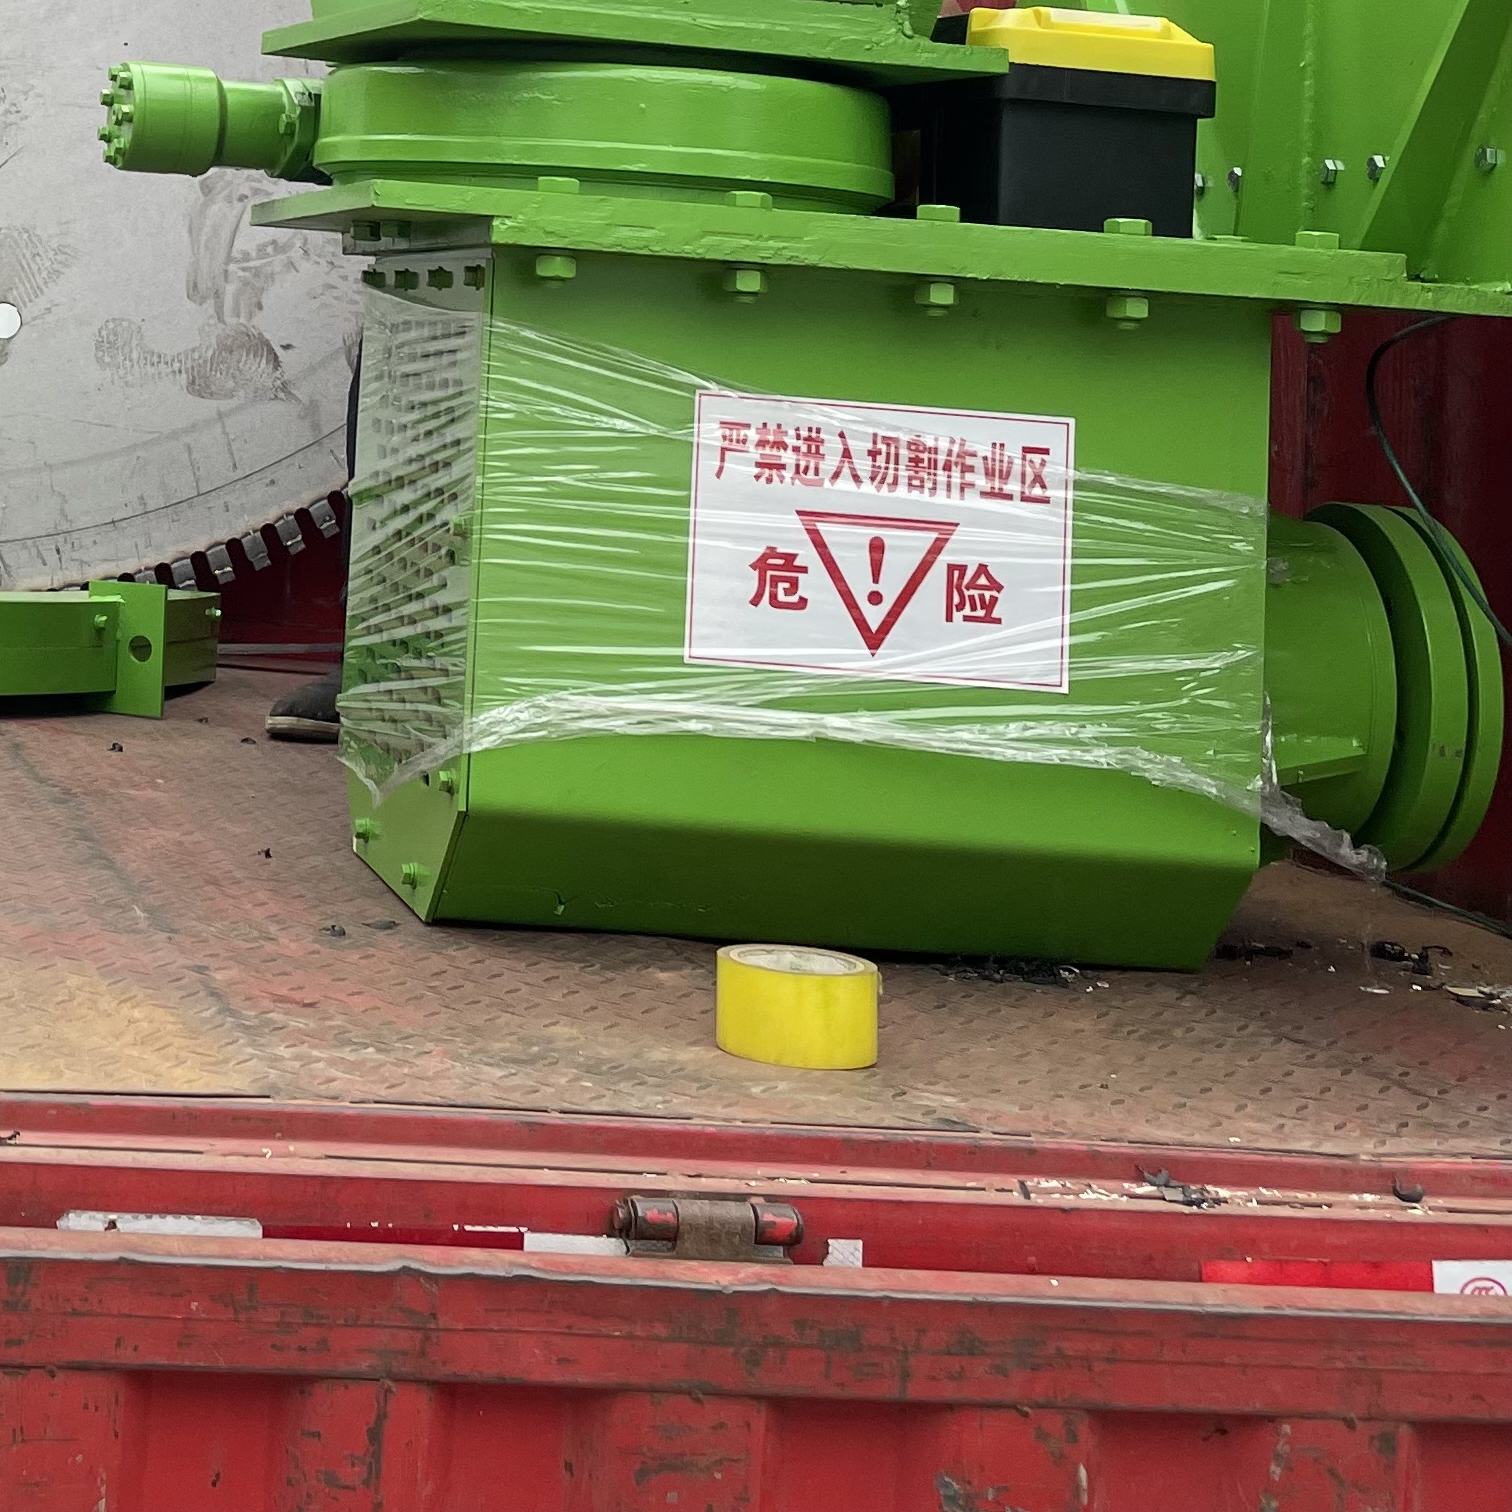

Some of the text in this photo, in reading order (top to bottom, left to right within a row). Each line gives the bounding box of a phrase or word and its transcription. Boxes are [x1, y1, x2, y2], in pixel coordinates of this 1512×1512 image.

[714, 420, 1052, 504] 严禁进入切割作业区
[748, 546, 1004, 625] 危 险
